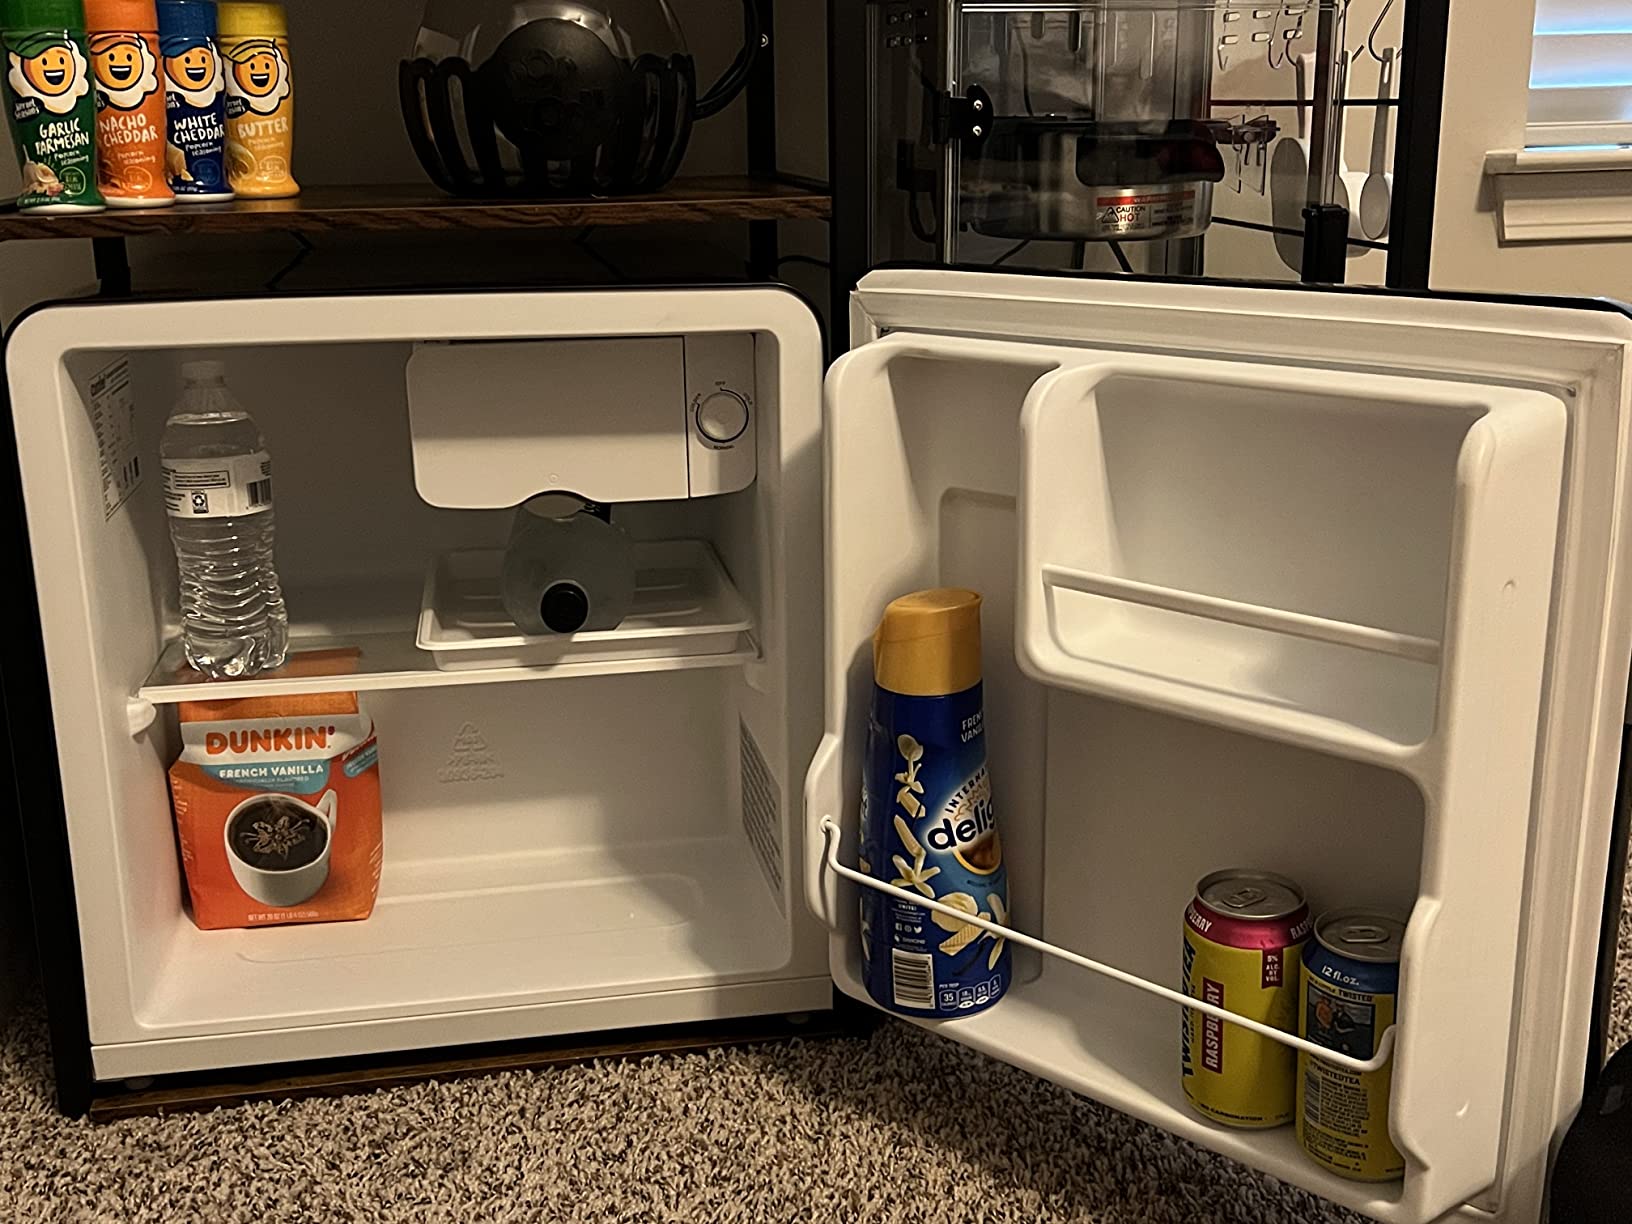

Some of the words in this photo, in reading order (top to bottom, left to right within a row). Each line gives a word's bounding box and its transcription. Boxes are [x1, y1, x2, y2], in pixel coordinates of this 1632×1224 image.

[40, 117, 80, 138] GARLIC
[100, 113, 147, 133] NACHO
[173, 112, 217, 130] WHITE
[237, 117, 289, 138] BUTTER
[35, 132, 89, 156] PARMESAN
[103, 125, 158, 147] CHEDDAR
[1116, 206, 1146, 214] CAUTION
[1119, 213, 1140, 222] HOT
[205, 726, 336, 756] DUNKIN'
[219, 767, 268, 779] FRENCH
[271, 764, 324, 776] VANILLA
[1321, 965, 1333, 977] 12
[943, 992, 955, 1002] 35
[1338, 988, 1375, 1003] TWISTED
[1205, 982, 1220, 1069] RASPBERY
